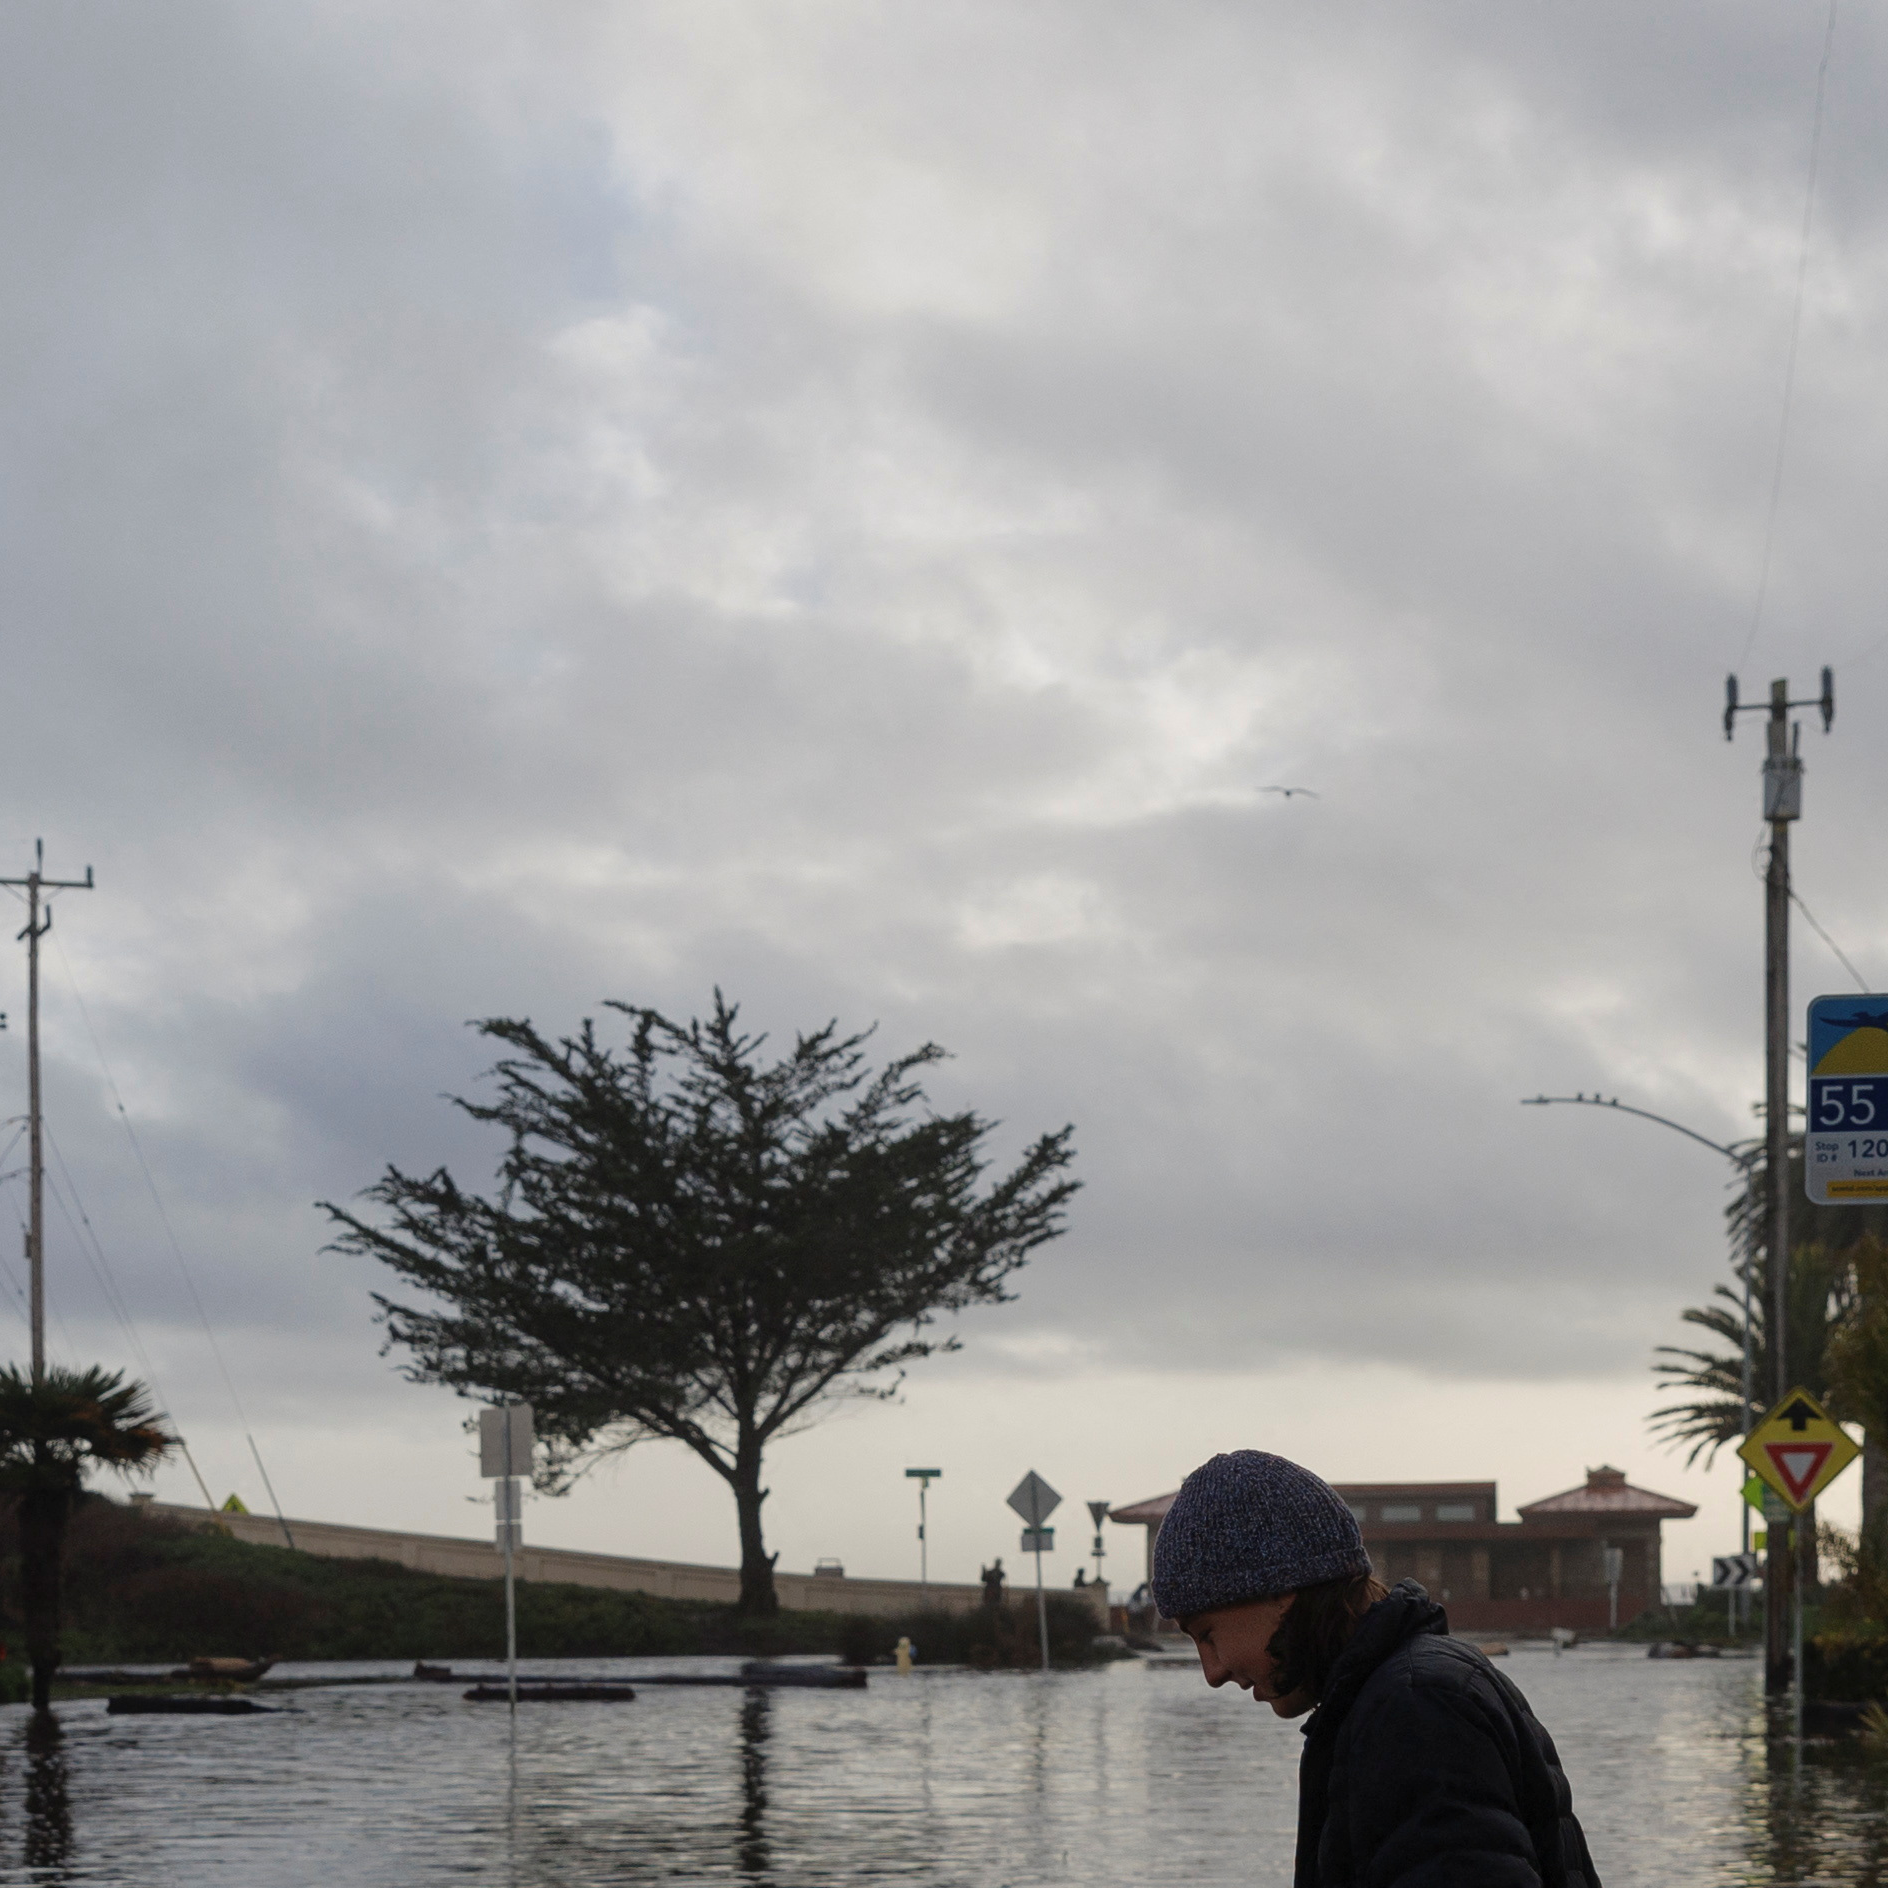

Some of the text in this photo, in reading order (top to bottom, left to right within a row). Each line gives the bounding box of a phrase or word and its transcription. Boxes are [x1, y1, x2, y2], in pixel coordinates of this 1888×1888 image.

[1819, 1084, 1876, 1126] 55
[1815, 1141, 1839, 1152] Stop
[1816, 1153, 1828, 1163] ID
[1853, 1168, 1875, 1177] Next
